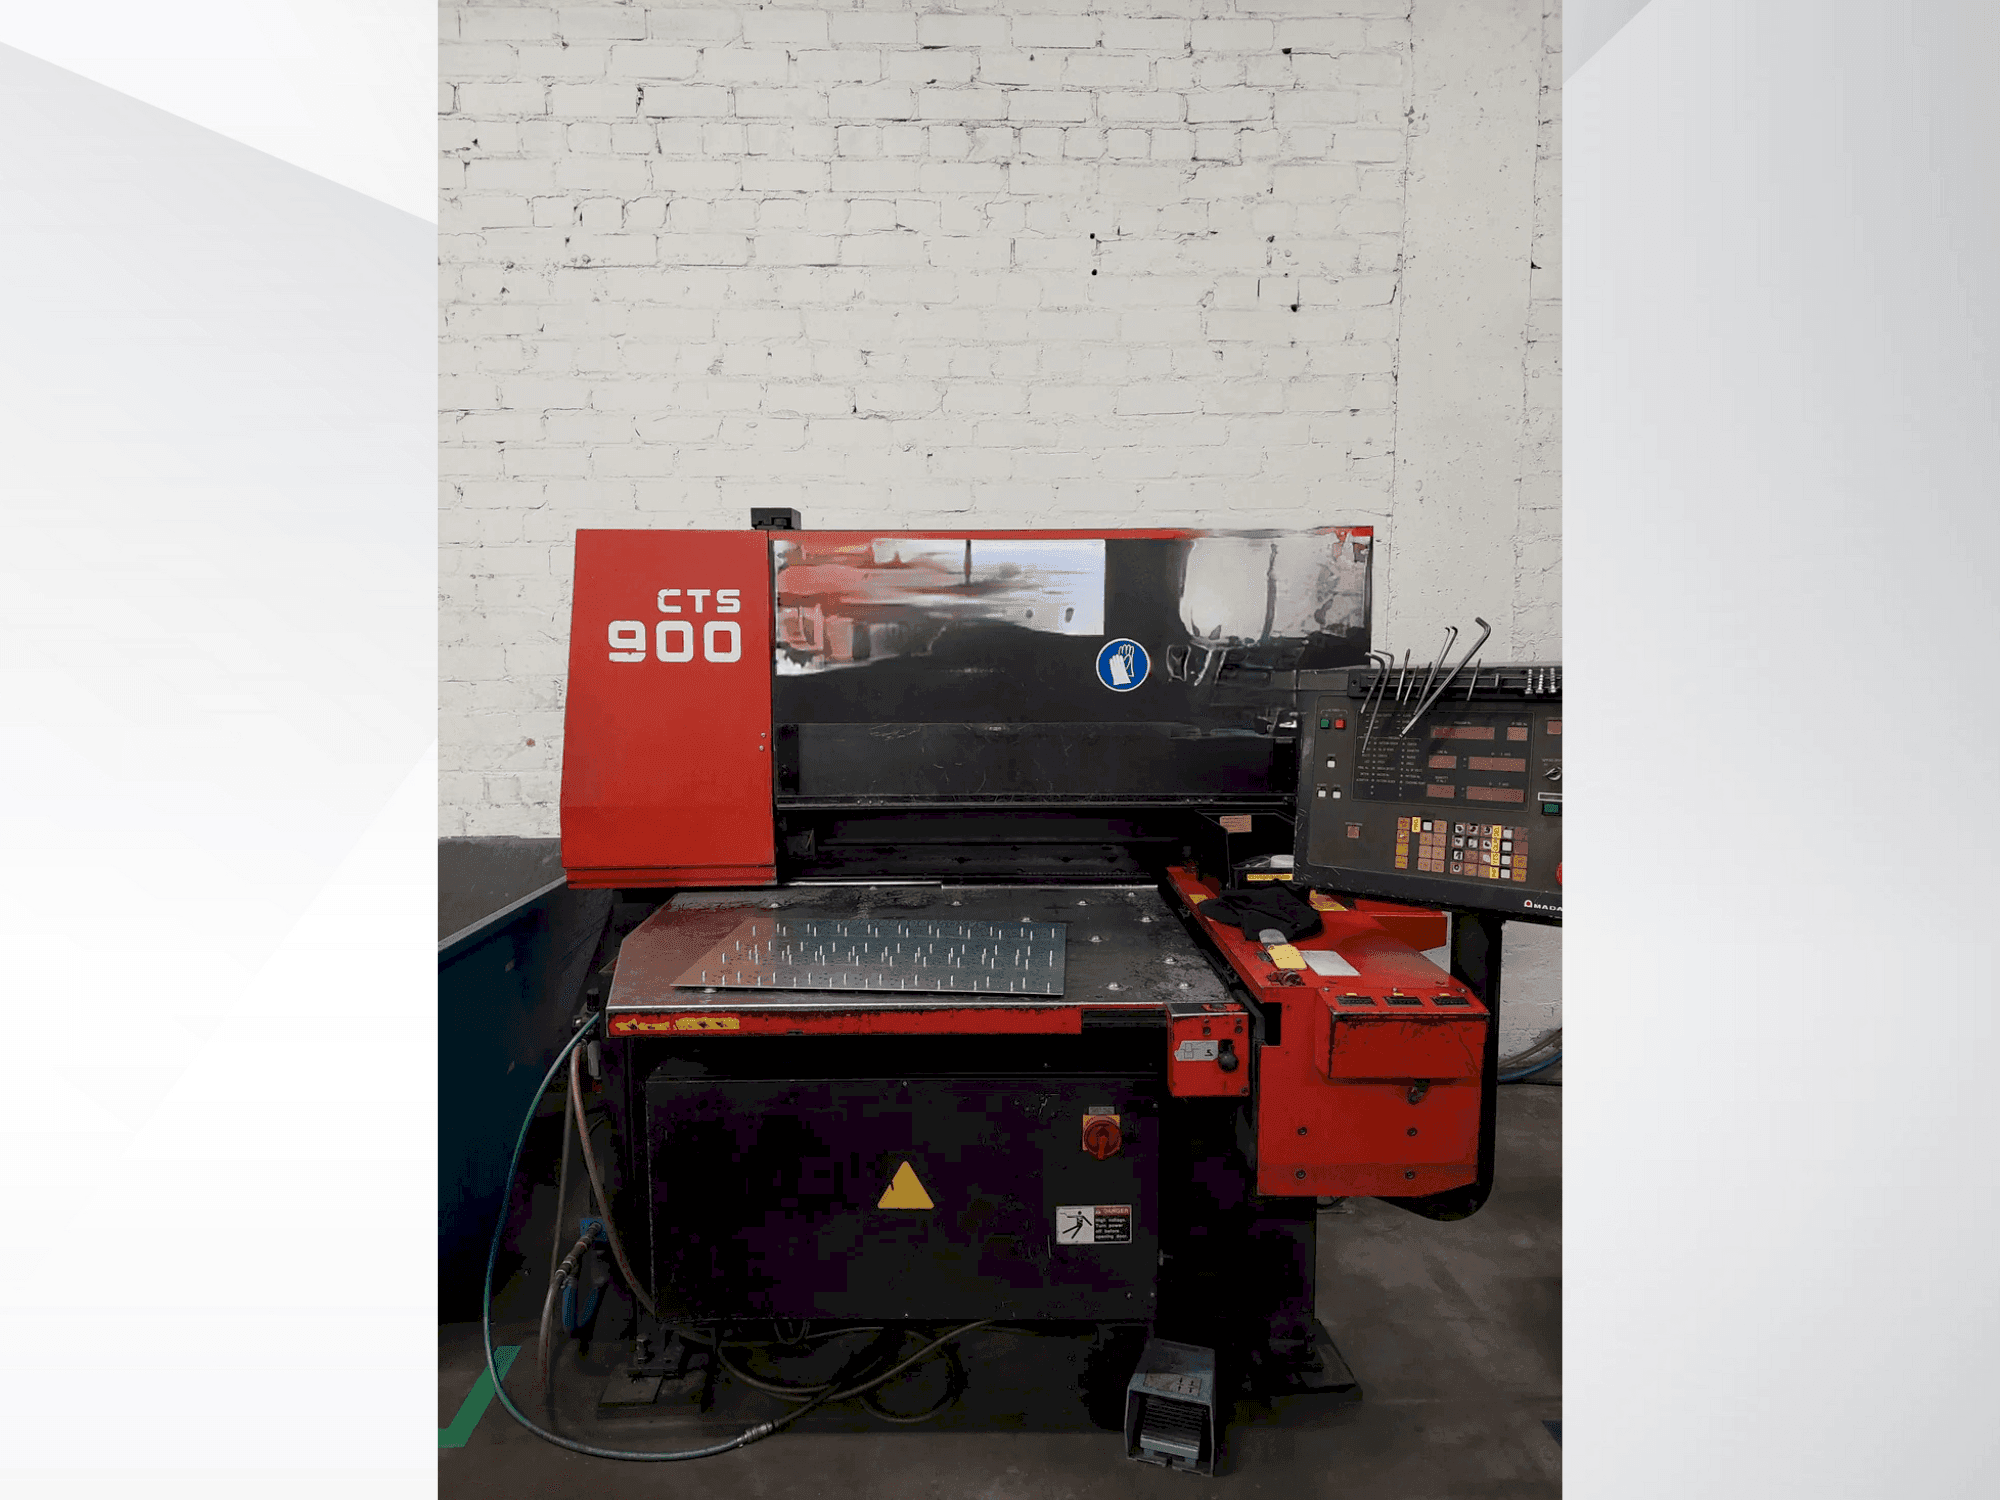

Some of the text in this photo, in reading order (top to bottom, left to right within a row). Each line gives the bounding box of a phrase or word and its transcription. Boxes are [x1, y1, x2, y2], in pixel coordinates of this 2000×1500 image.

[657, 588, 741, 613] CTS
[608, 620, 742, 663] 900
[1524, 899, 1562, 911] AMADA
